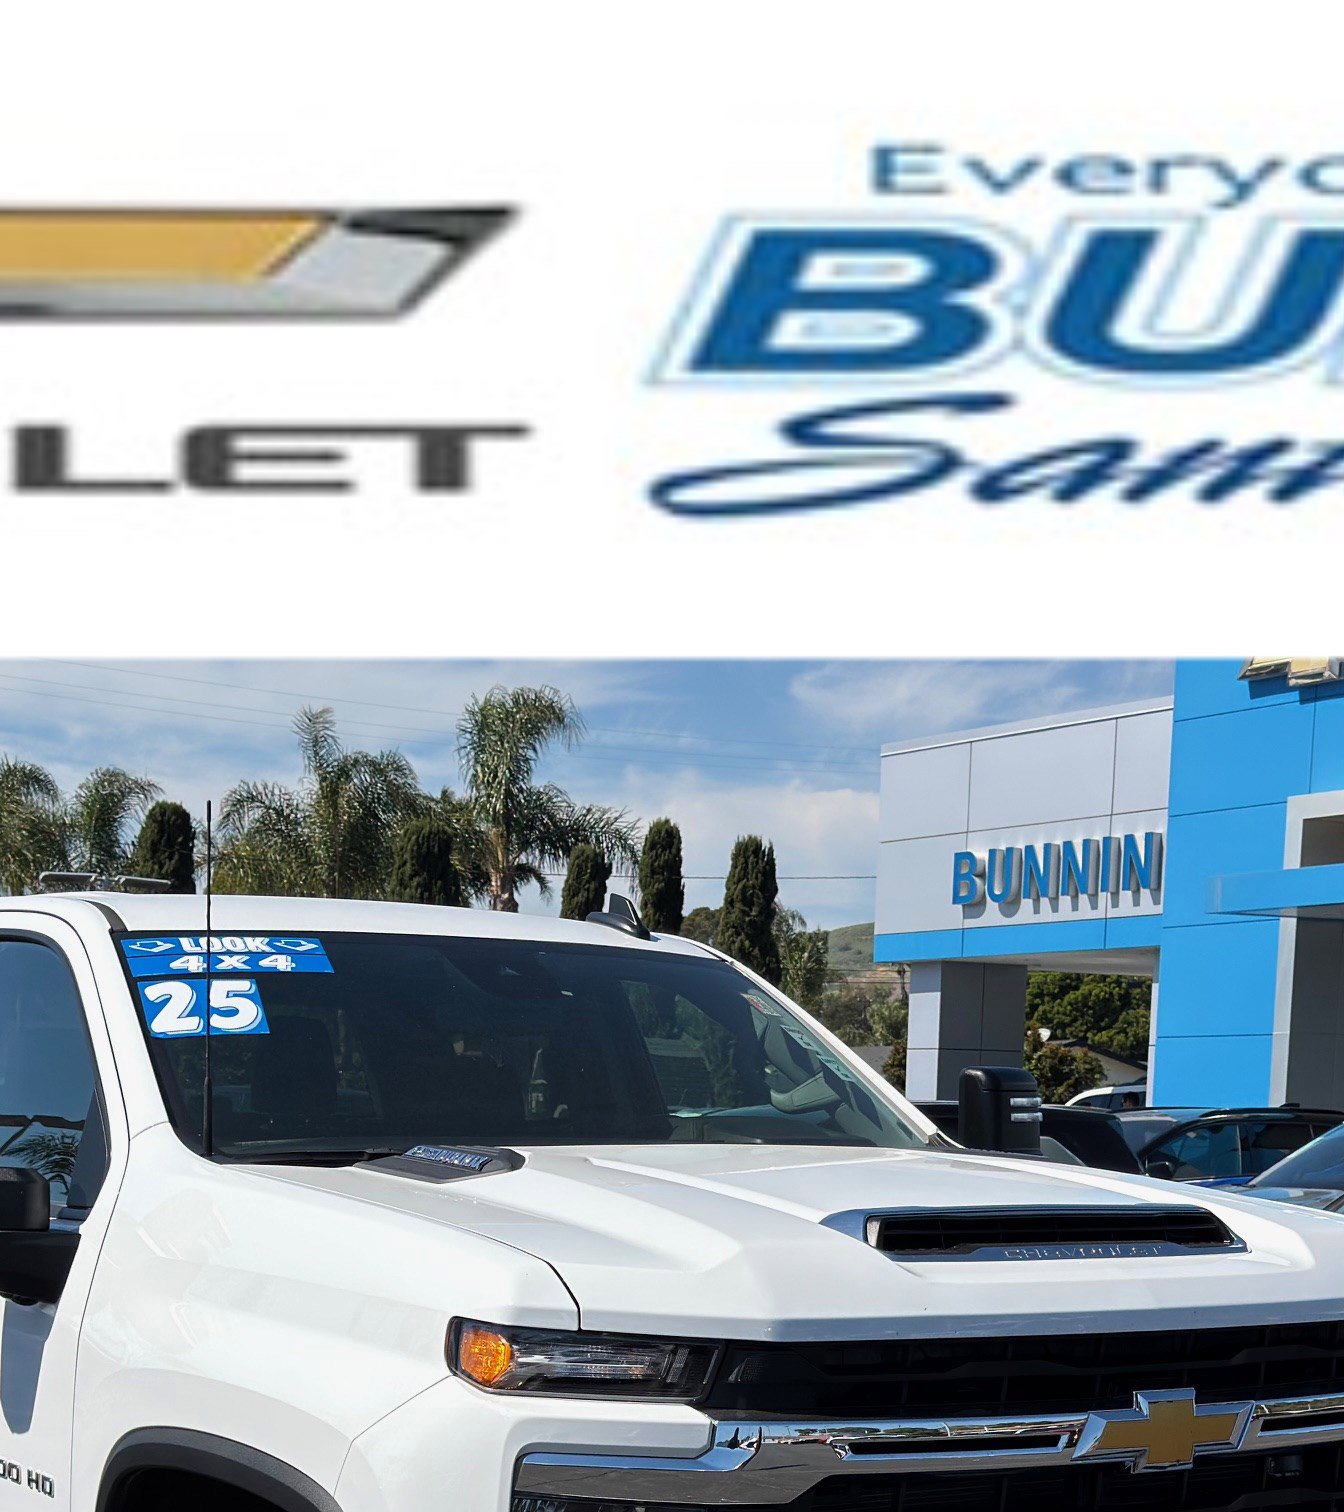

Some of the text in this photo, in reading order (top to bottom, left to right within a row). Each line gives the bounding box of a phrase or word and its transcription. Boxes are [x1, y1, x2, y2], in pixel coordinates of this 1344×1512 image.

[951, 831, 1162, 908] BUNNIN
[178, 937, 276, 953] LOOK
[144, 980, 262, 1035] 25
[26, 1468, 55, 1499] HD
